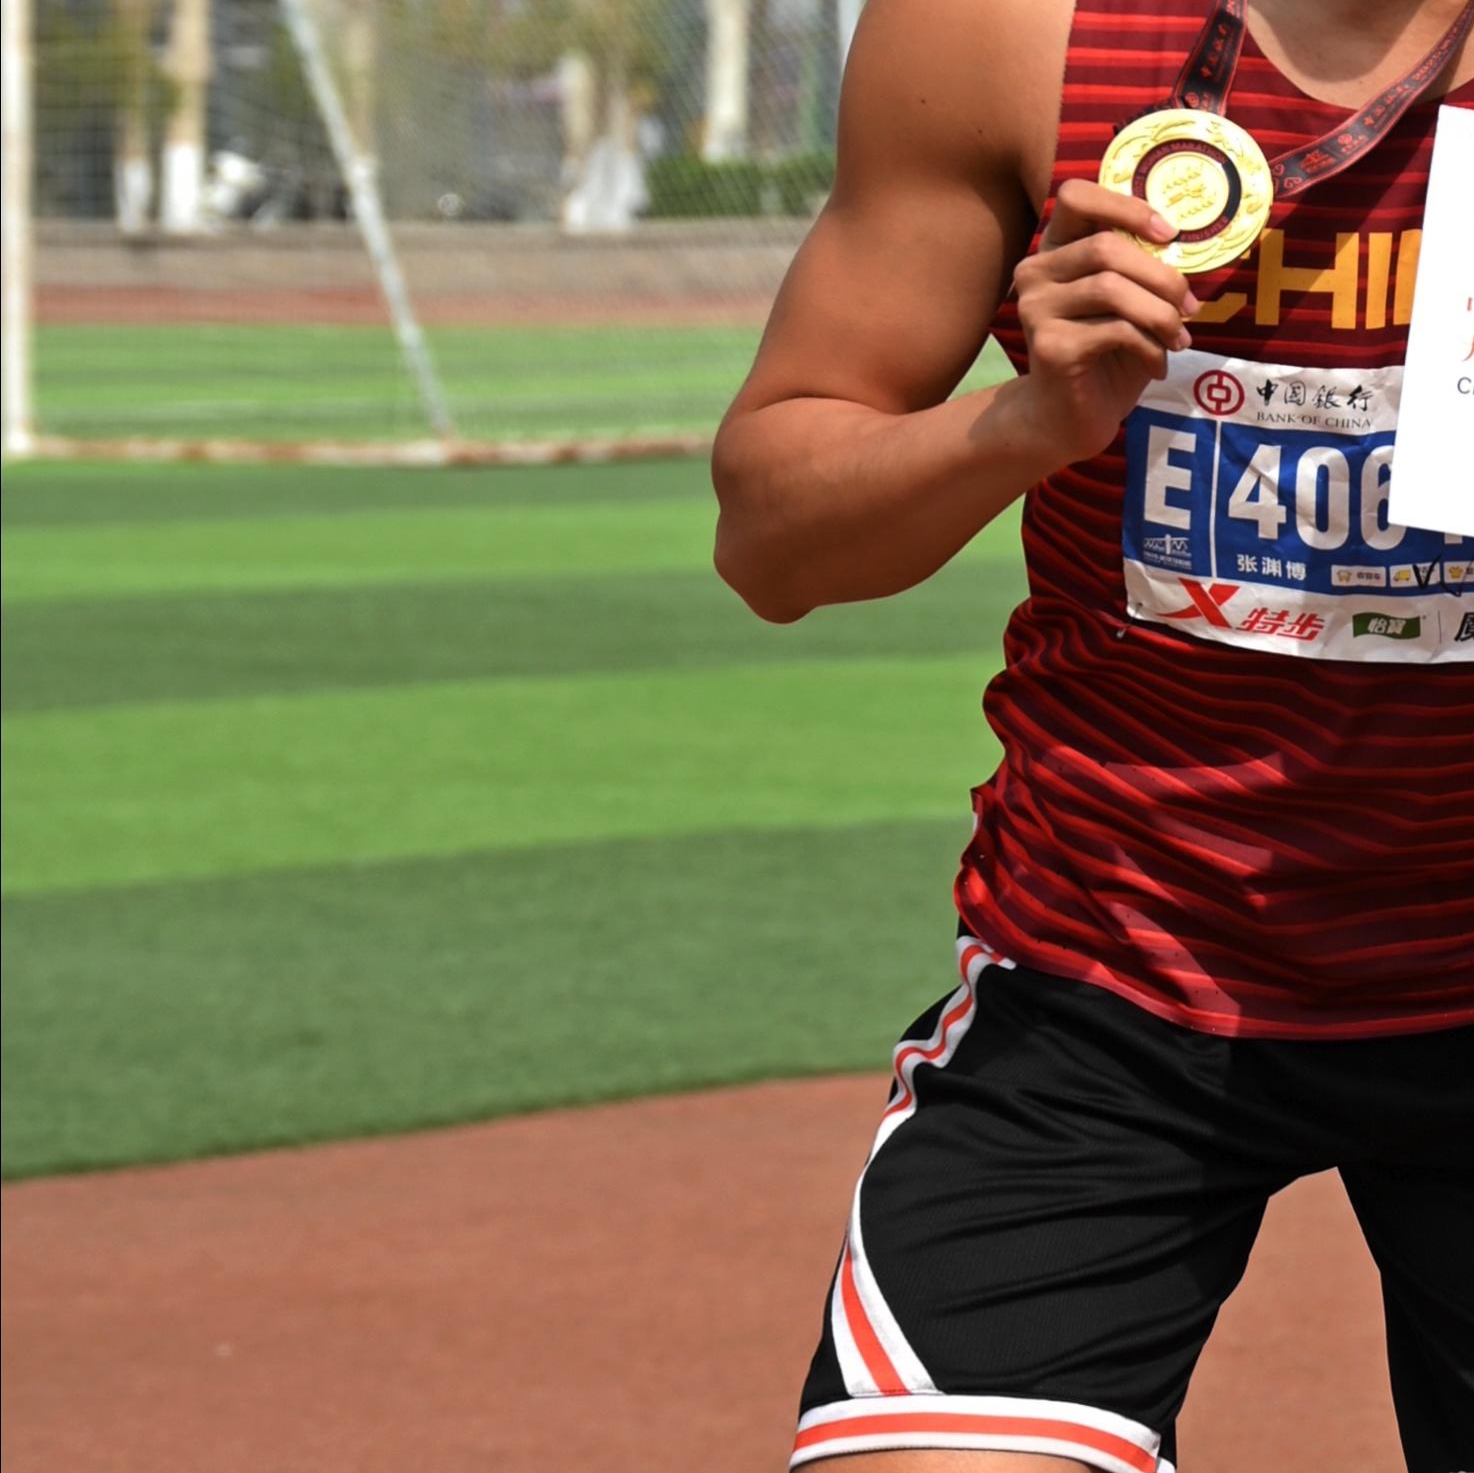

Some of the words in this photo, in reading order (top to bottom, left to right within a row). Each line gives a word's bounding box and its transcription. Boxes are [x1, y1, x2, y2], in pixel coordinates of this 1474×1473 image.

[1256, 411, 1296, 424] BANK
[1301, 415, 1320, 425] OF
[1325, 416, 1371, 429] CHINA
[1143, 425, 1197, 530] E
[1236, 554, 1307, 580] 张渊博
